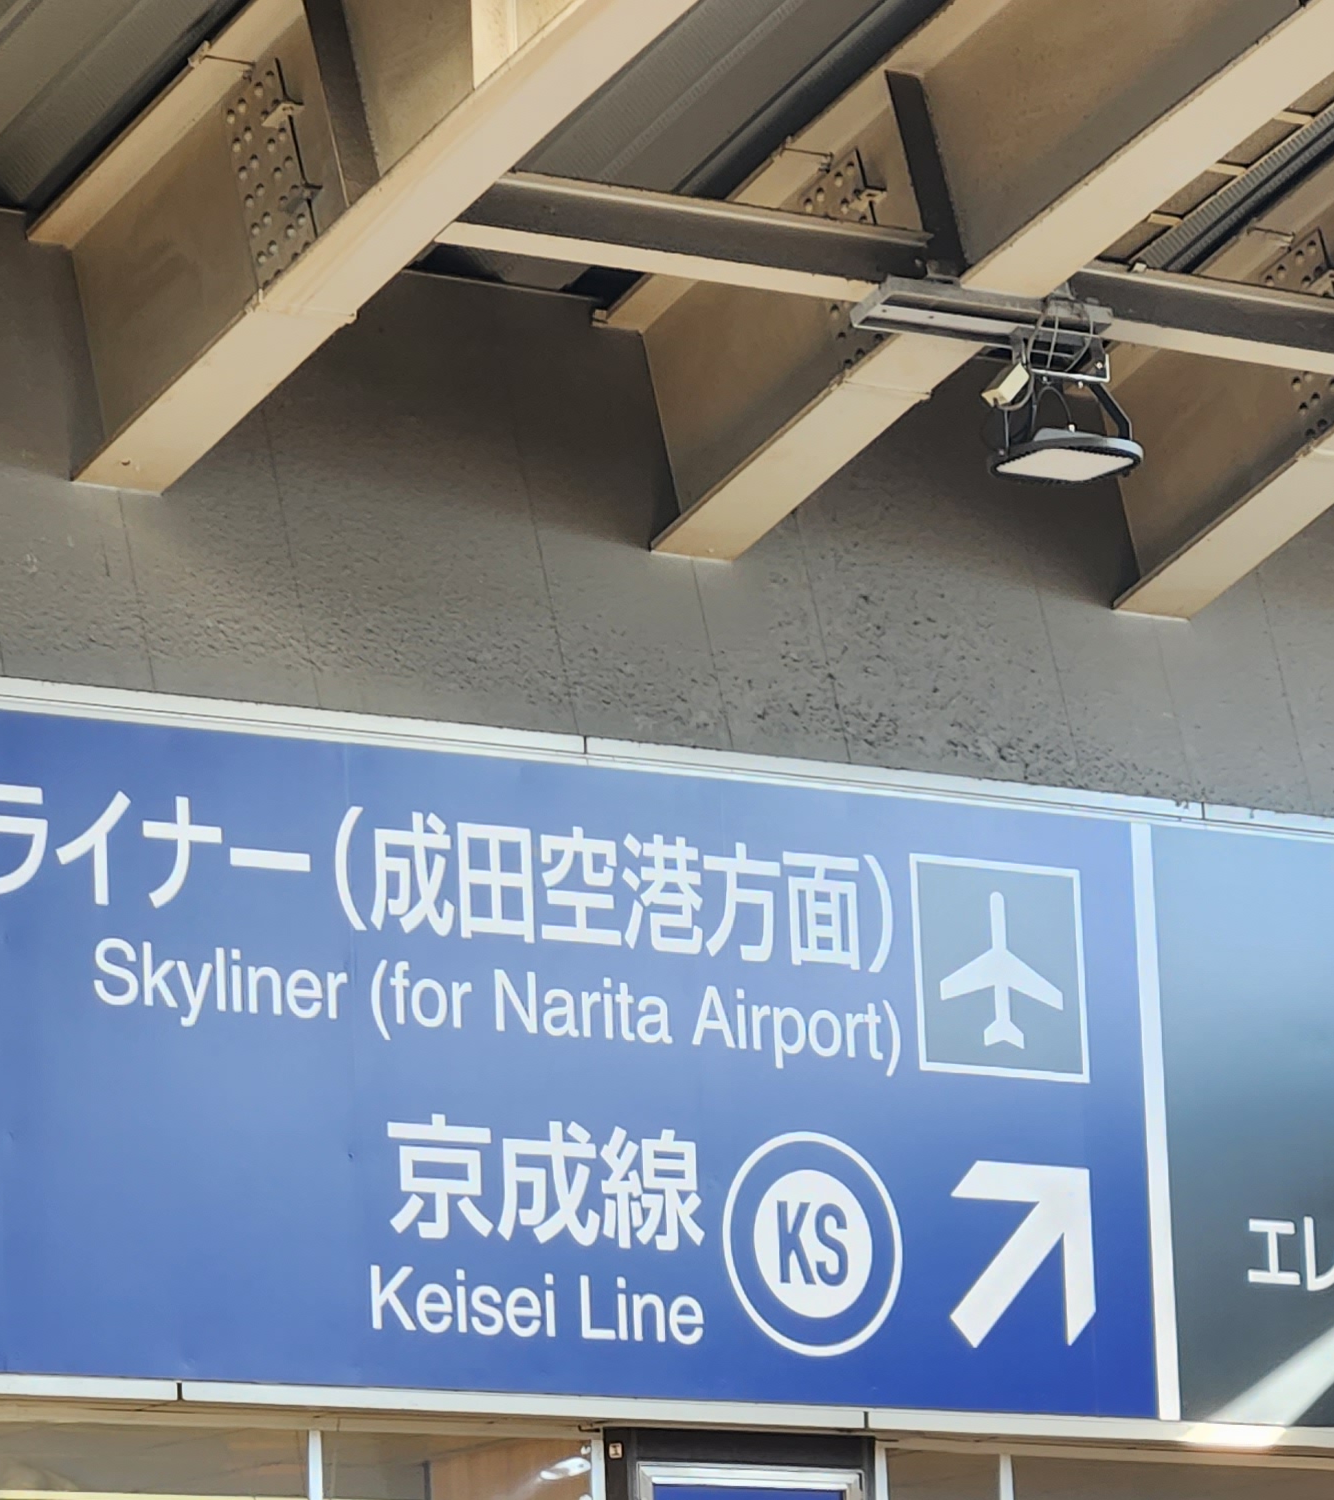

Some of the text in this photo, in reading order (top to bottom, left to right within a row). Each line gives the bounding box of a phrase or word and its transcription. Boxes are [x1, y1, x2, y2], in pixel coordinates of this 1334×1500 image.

[92, 938, 904, 1076] Skyliner (for Narita Airport)
[387, 1114, 706, 1253] 京成線
[775, 1198, 849, 1289] KS
[369, 1263, 705, 1345] Keisei Line
